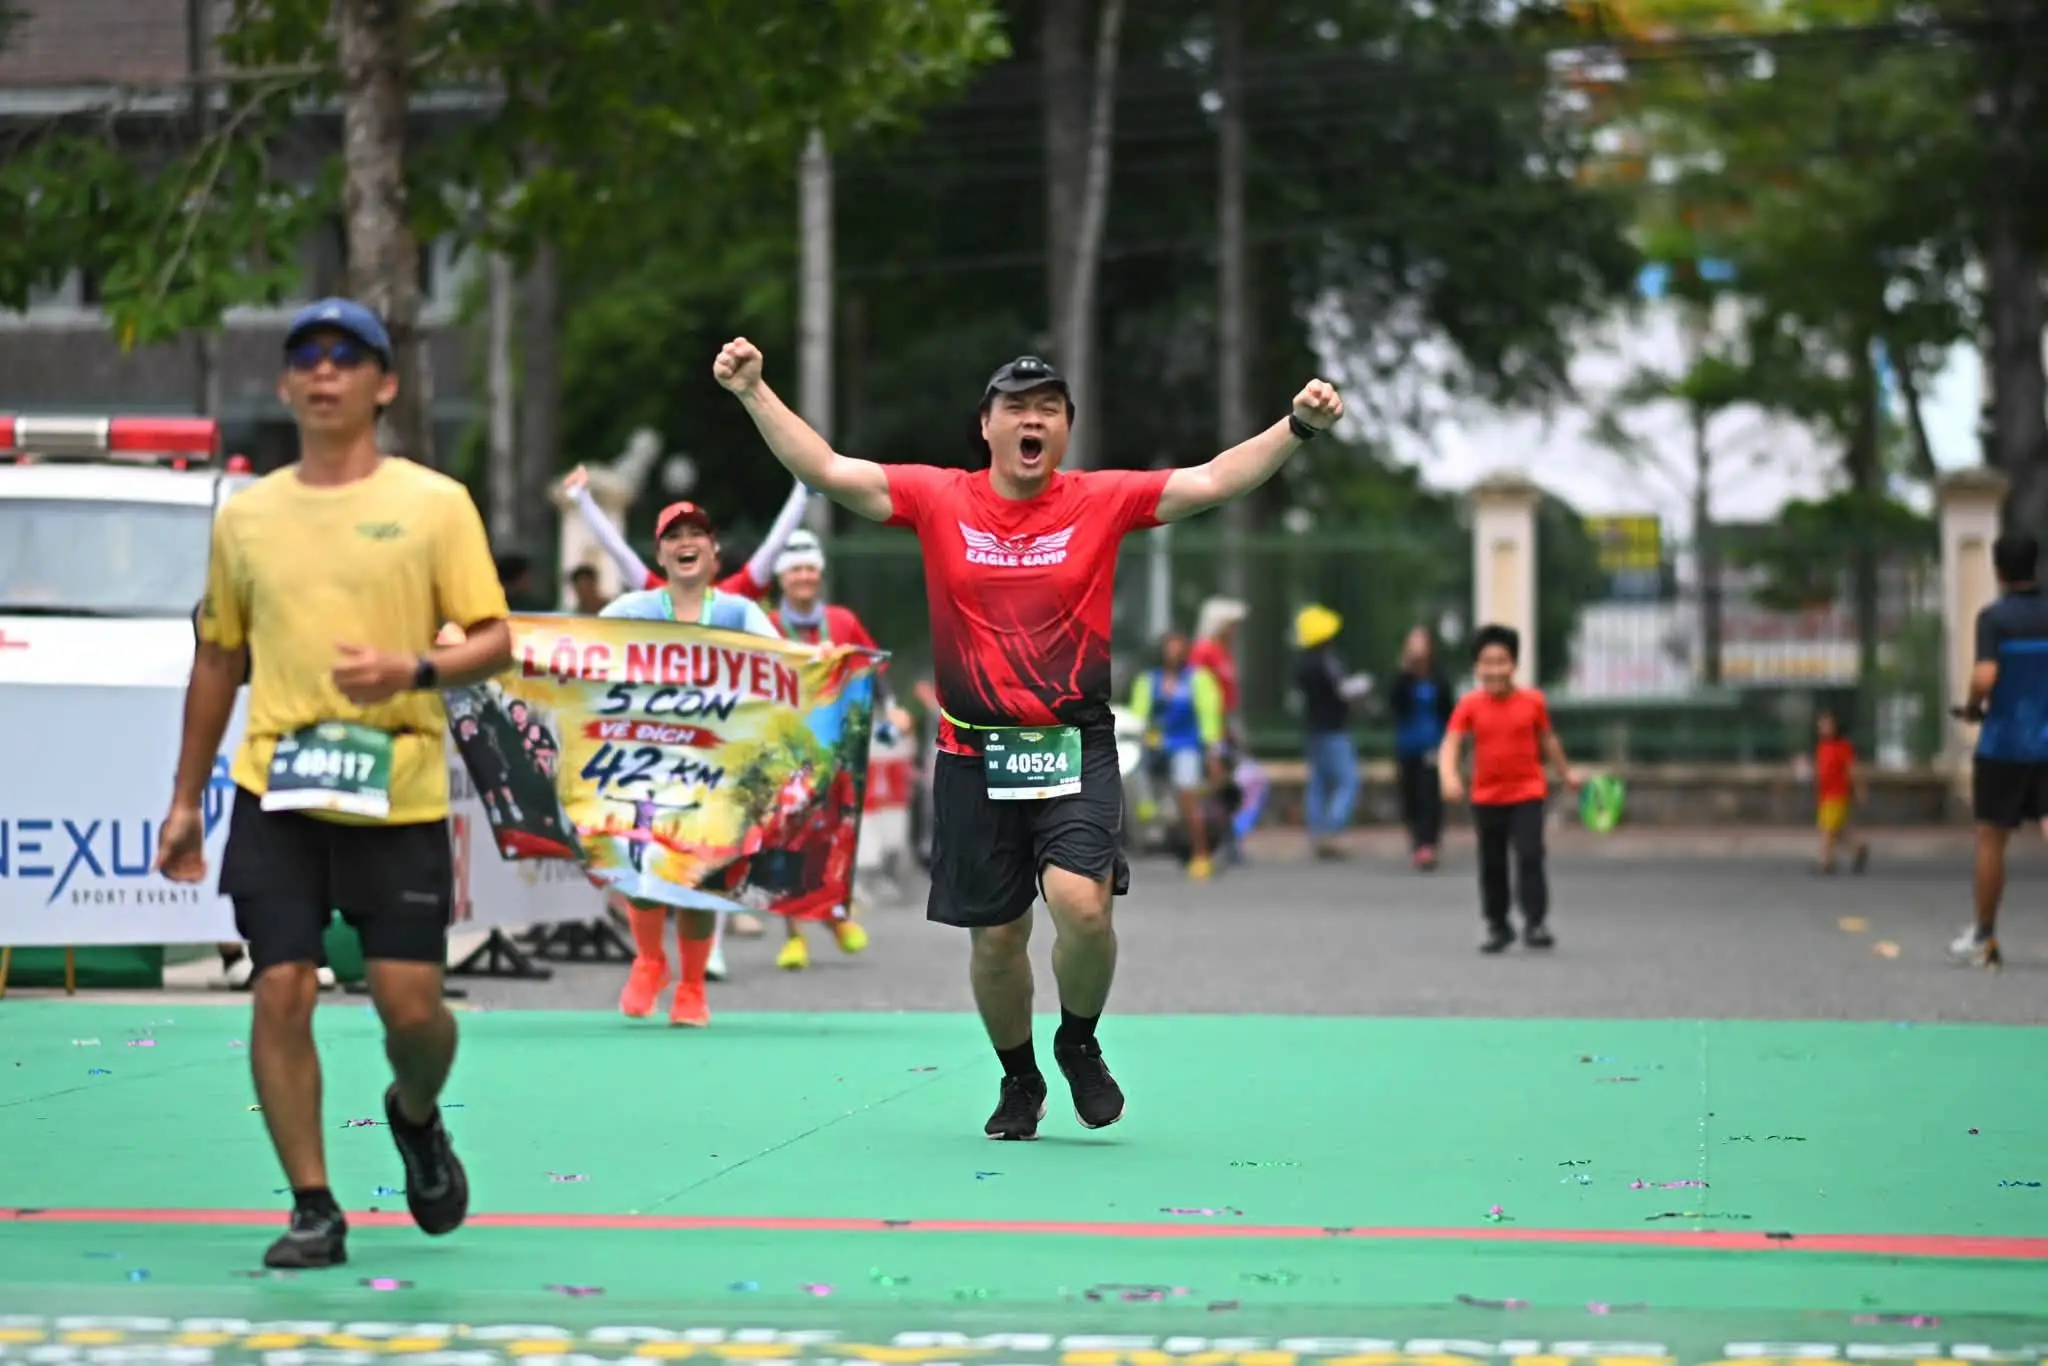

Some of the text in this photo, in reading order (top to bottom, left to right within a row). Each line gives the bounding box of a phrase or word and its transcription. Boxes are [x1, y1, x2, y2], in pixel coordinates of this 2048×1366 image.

[966, 548, 1067, 567] EAGLE CAMP
[599, 682, 740, 721] 5 CON
[580, 743, 725, 793] 42 KM
[988, 752, 1068, 773] M 40524
[72, 889, 199, 904] SPORT EVENTS
